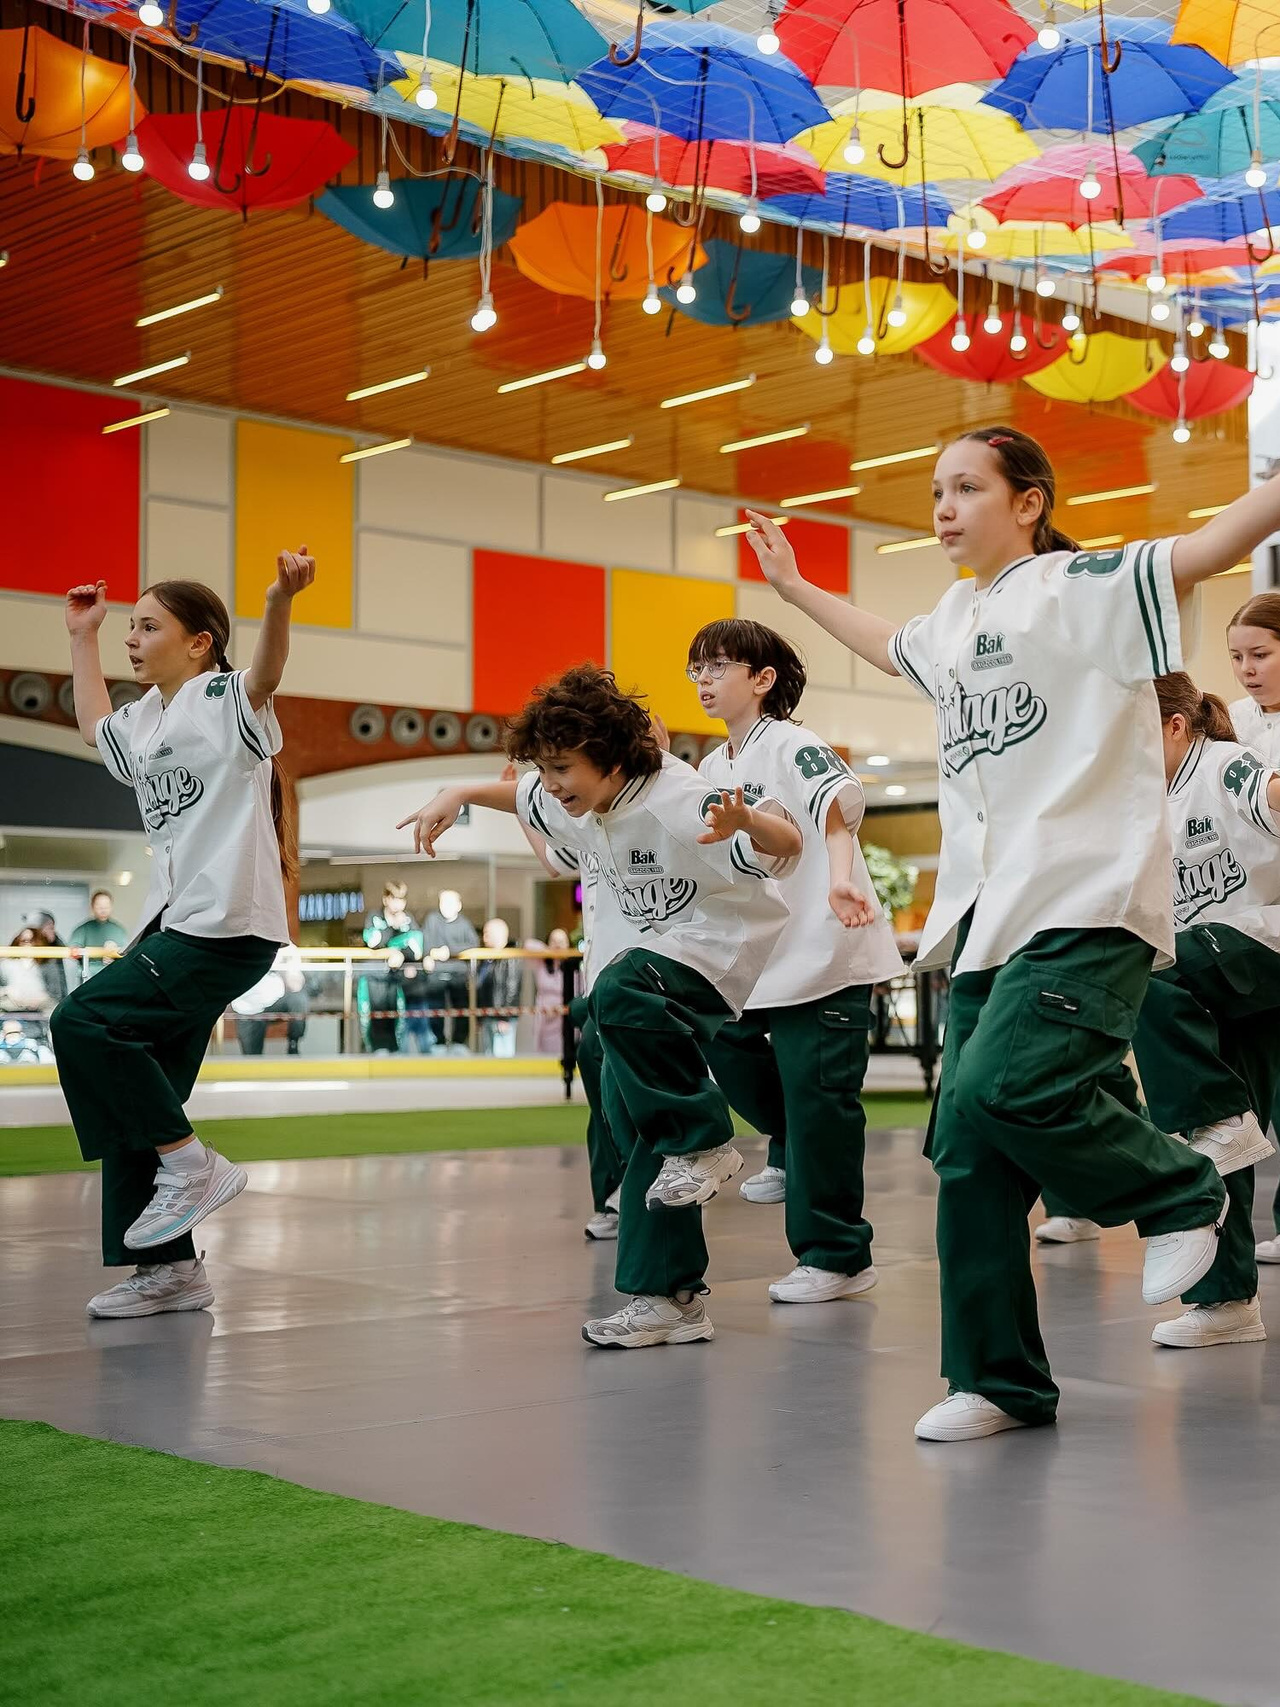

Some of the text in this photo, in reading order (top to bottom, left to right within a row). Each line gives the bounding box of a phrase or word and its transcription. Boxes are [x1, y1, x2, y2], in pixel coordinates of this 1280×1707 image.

[975, 633, 1005, 657] Bak
[1186, 816, 1213, 838] Bak
[630, 849, 656, 865] Bak
